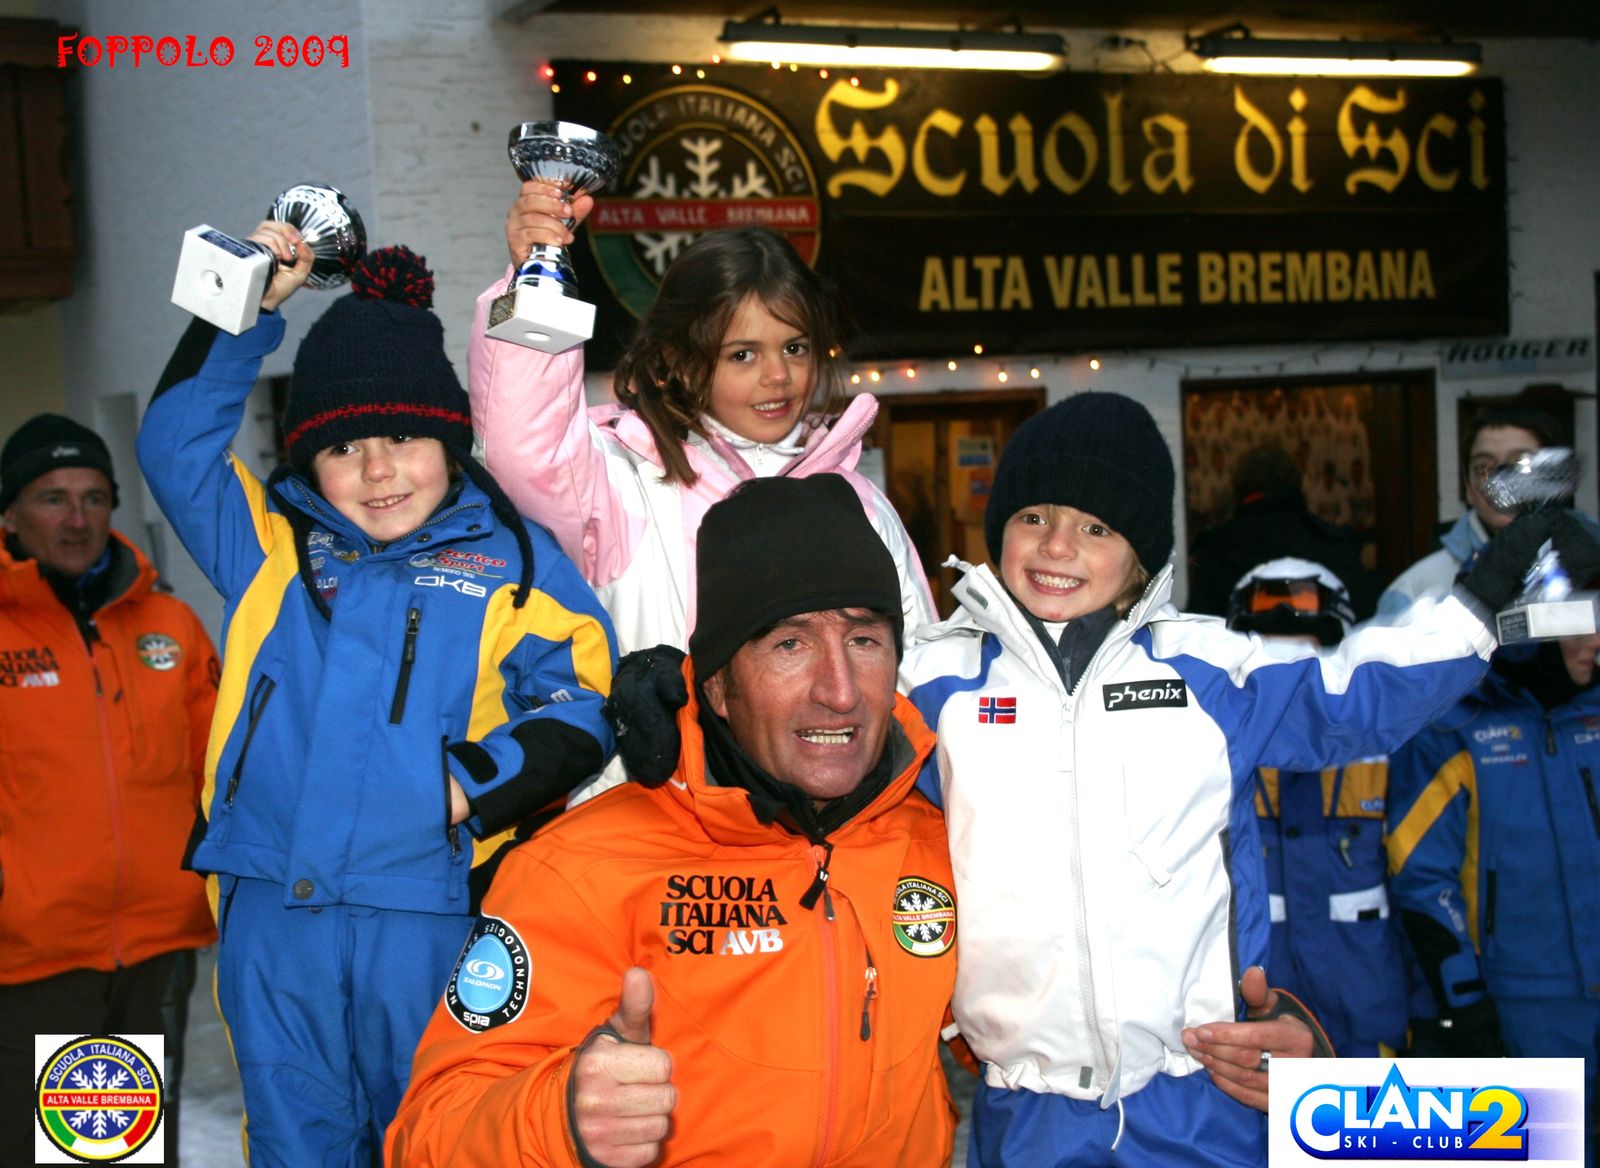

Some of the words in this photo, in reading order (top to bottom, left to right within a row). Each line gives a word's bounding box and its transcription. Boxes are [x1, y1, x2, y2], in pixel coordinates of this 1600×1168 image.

[678, 94, 776, 148] ITALIANA
[815, 77, 1194, 199] Scuola
[1234, 83, 1314, 195] di
[1337, 84, 1490, 195] Sci
[600, 205, 645, 224] ALTA
[655, 205, 708, 224] VALLE
[919, 255, 1032, 312] ALTA
[1044, 252, 1183, 310] VALLE
[1199, 248, 1435, 305] BREMBANA
[1108, 682, 1183, 708] phenix
[666, 875, 778, 902] SCUOLA
[906, 882, 937, 895] ITALIANA
[937, 891, 949, 903] SCI
[660, 902, 788, 928] ITALIANA
[667, 929, 715, 954] SCI
[720, 928, 784, 955] AVB
[463, 976, 502, 991] SALOMON
